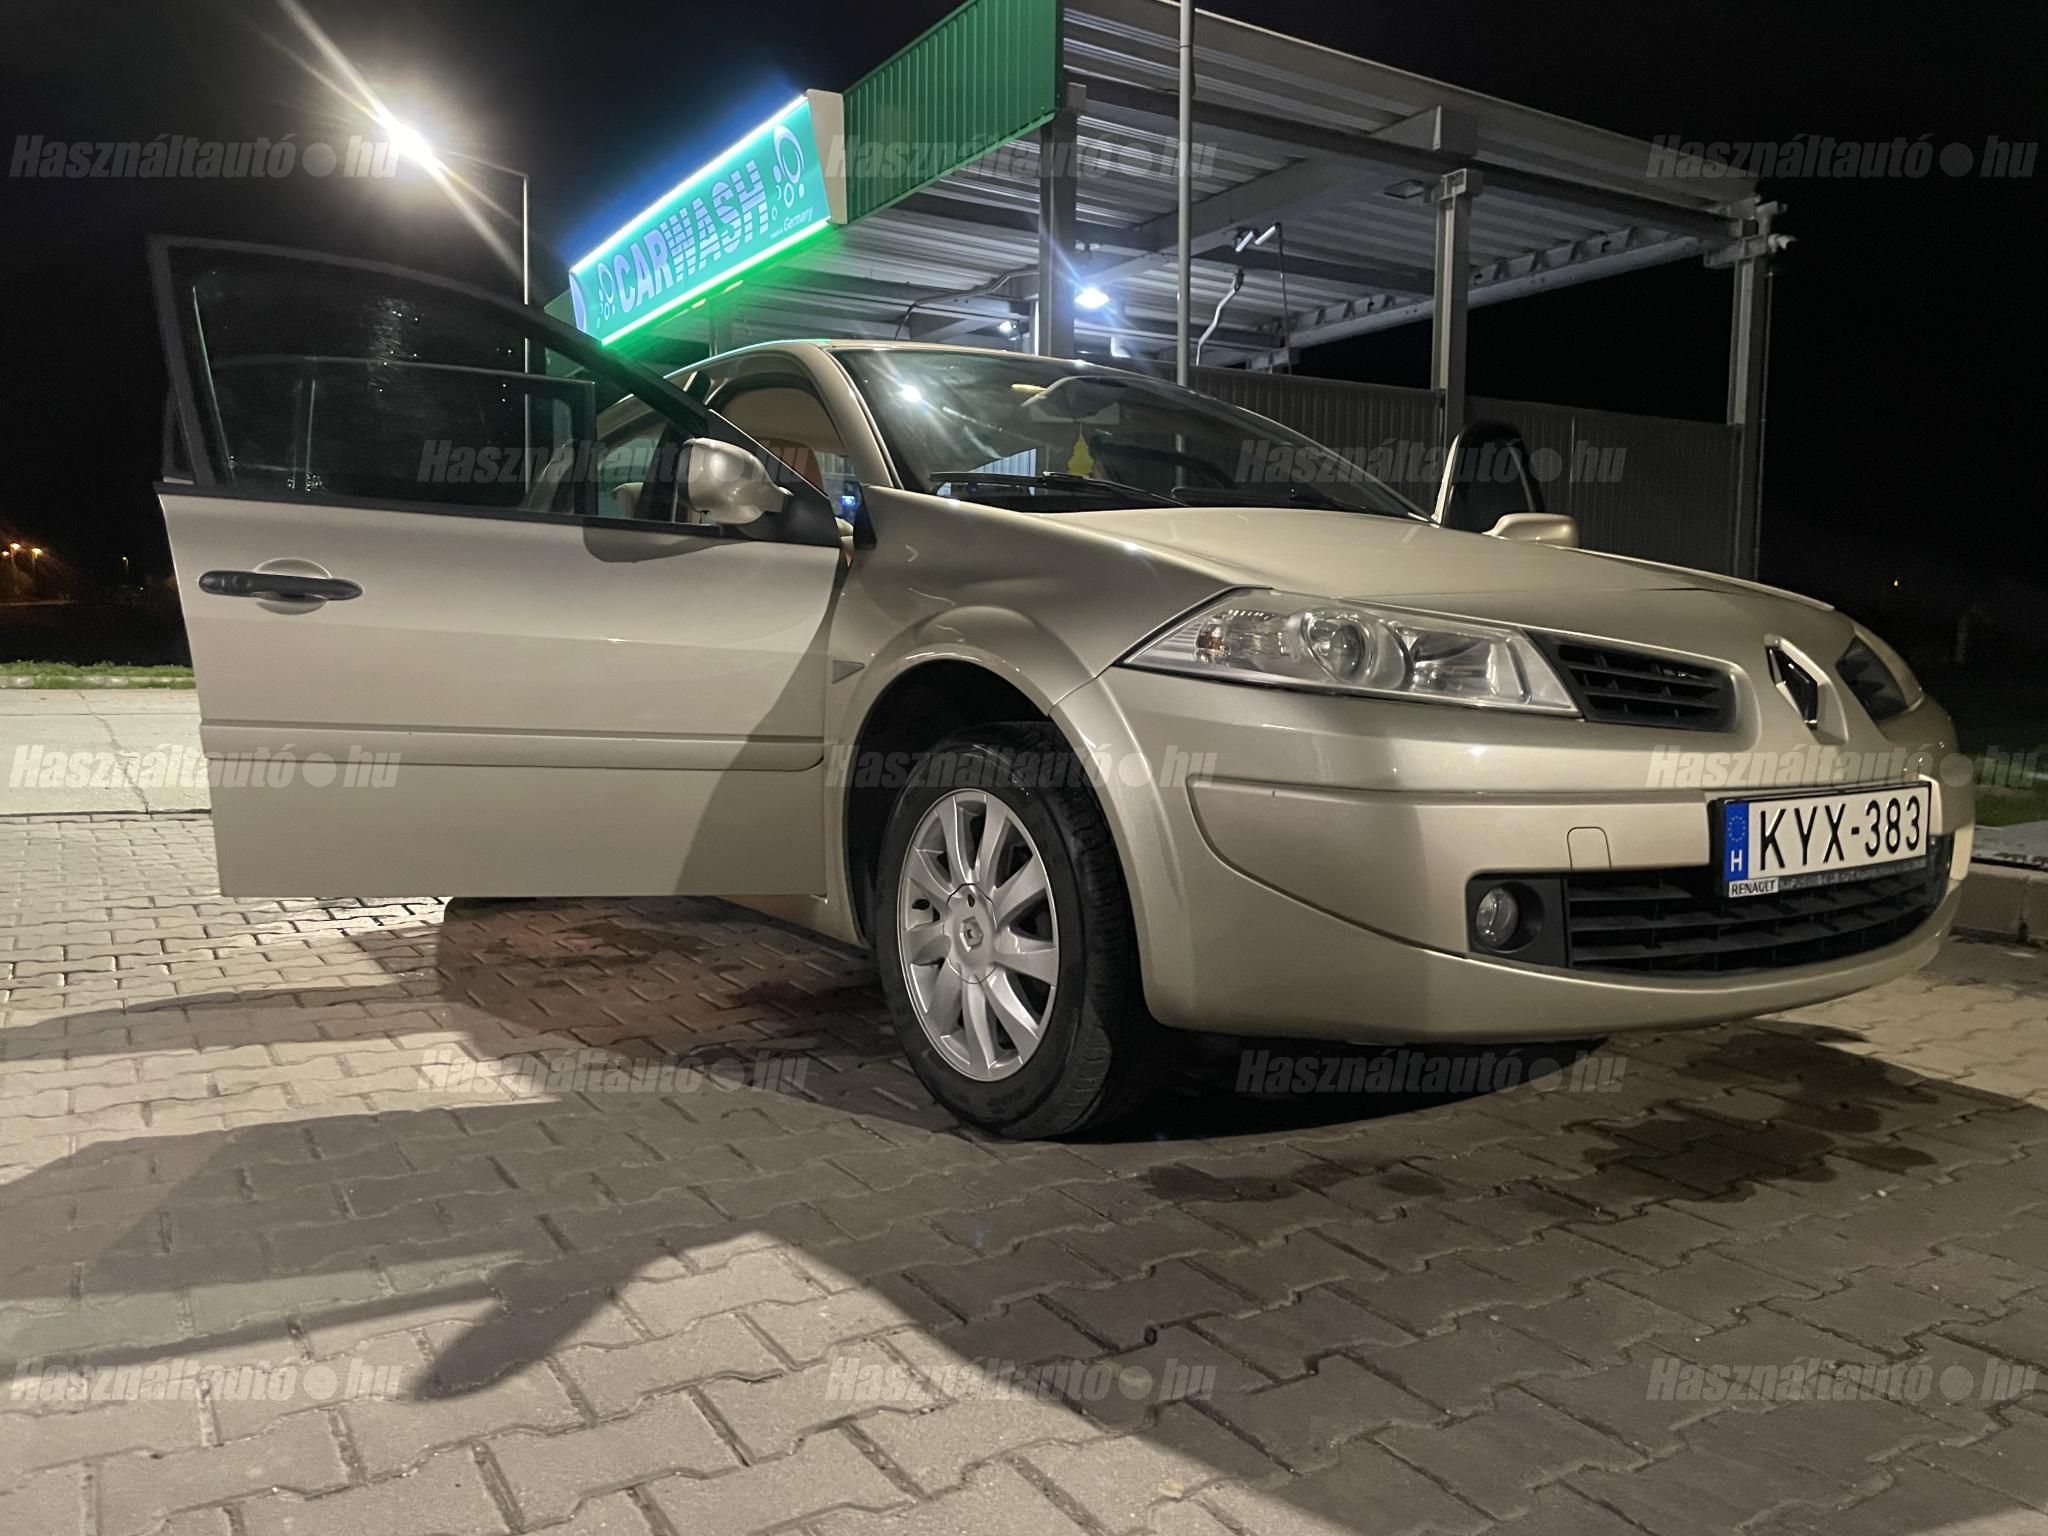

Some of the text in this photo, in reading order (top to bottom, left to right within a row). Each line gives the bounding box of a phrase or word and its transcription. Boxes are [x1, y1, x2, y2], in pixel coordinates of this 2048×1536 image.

[613, 160, 768, 313] CARWASH
[1759, 796, 1921, 871] KYX-383
[1730, 850, 1743, 872] H
[1730, 880, 1777, 896] RENAULT
